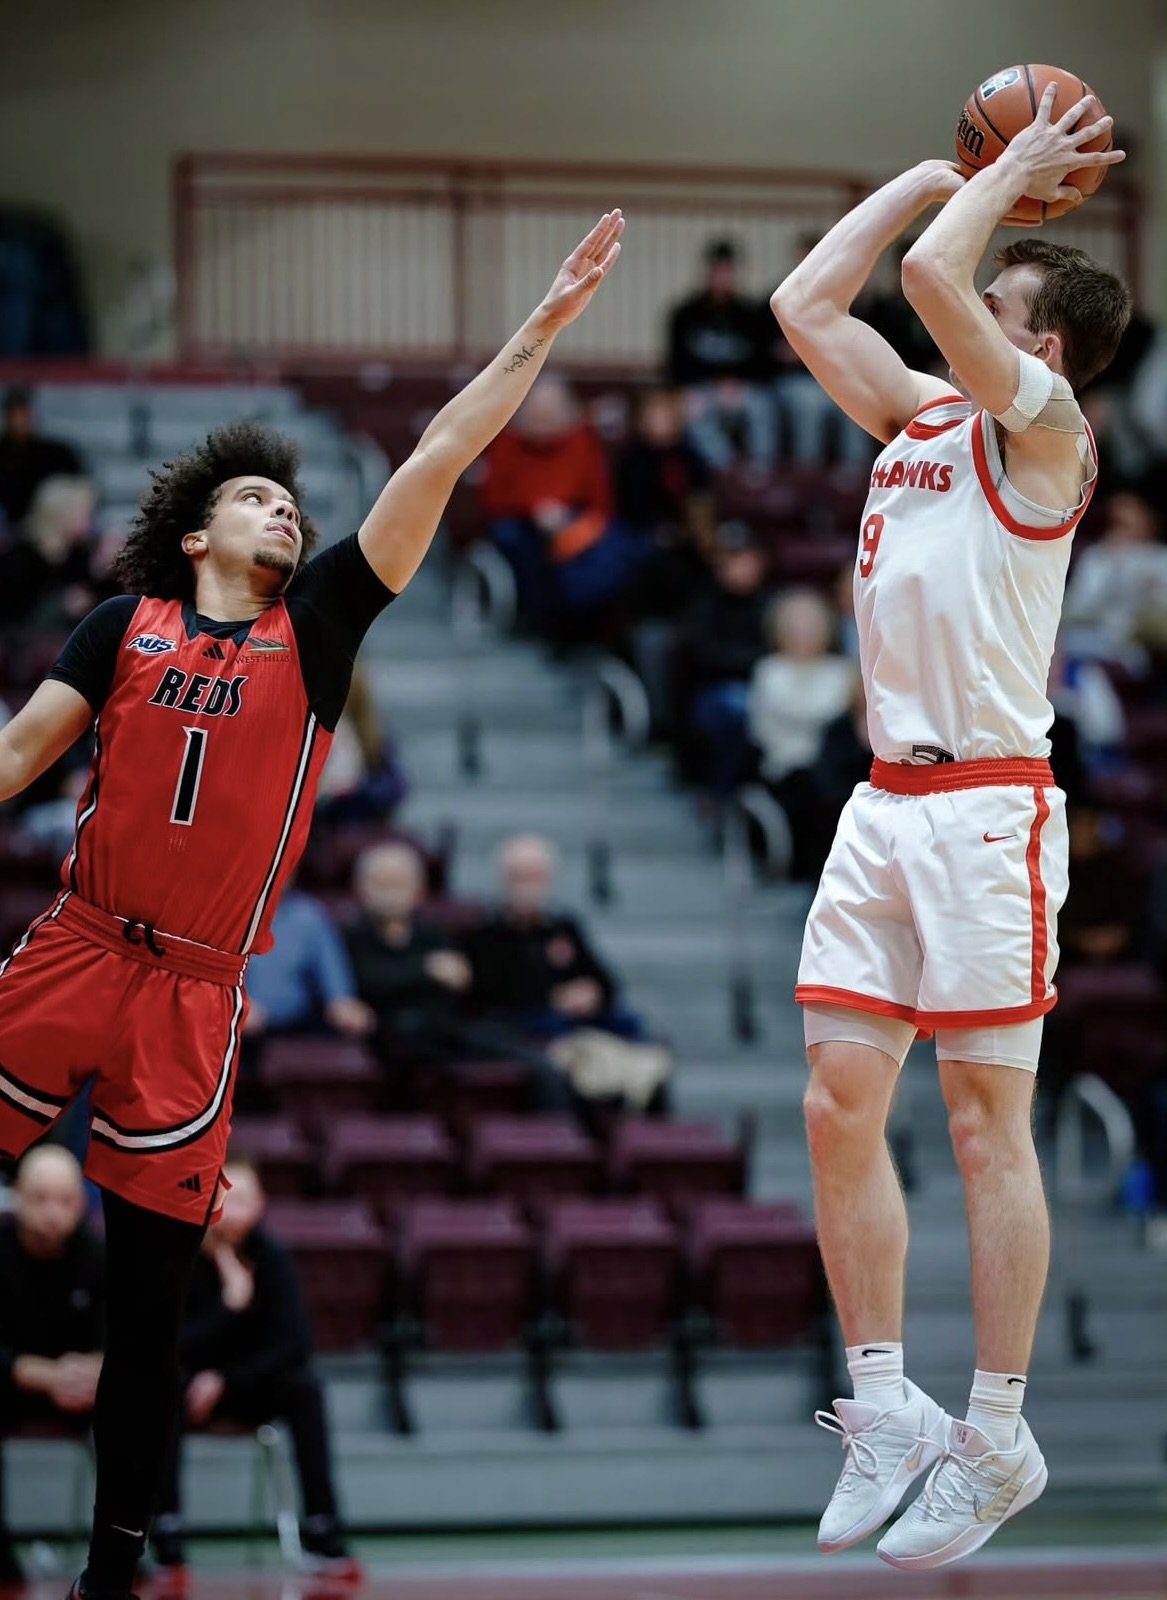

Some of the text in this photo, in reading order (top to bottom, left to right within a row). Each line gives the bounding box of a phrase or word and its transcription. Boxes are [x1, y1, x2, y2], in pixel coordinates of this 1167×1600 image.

[957, 111, 984, 159] Wil
[127, 634, 177, 655] AUS
[234, 653, 290, 664] WEST HILLS
[148, 666, 249, 717] REDS
[169, 725, 209, 826] 1
